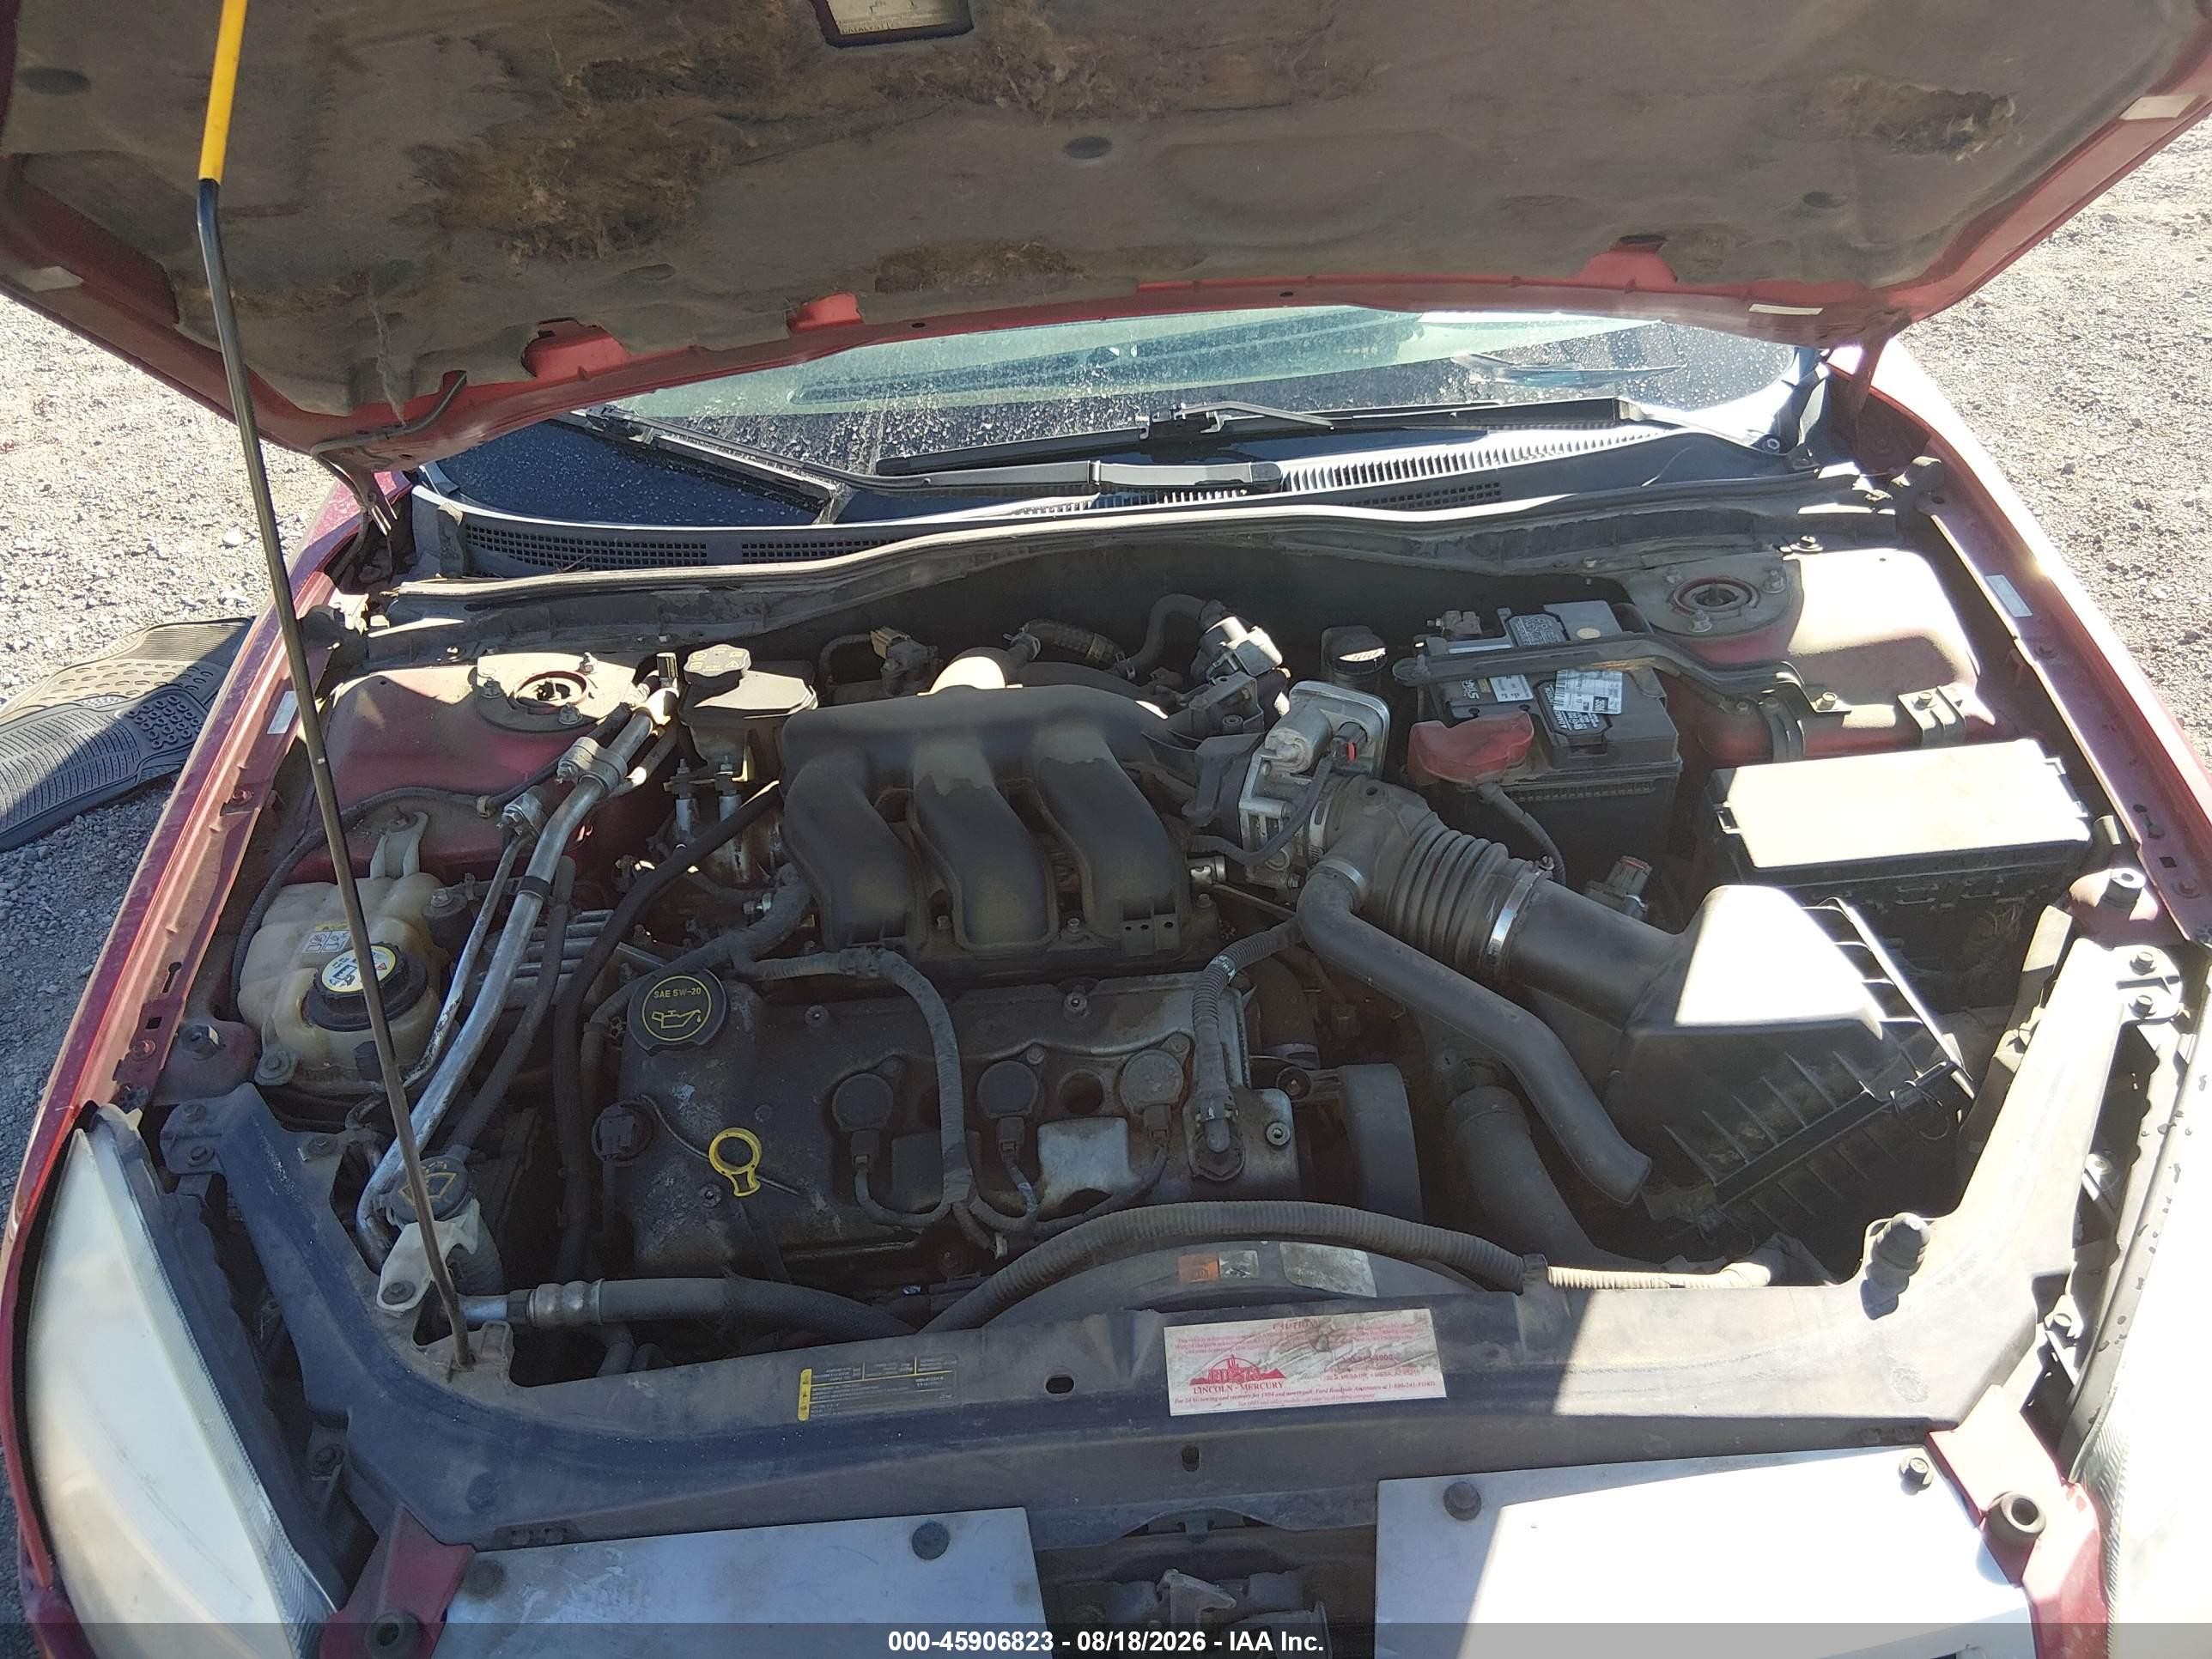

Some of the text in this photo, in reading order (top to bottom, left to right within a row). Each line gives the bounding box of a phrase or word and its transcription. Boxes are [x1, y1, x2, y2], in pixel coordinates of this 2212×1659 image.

[653, 988, 702, 999] SAE 5W-20
[1273, 1319, 1318, 1331] CAUTION
[1193, 1381, 1285, 1395] LINCOLN MERCURY
